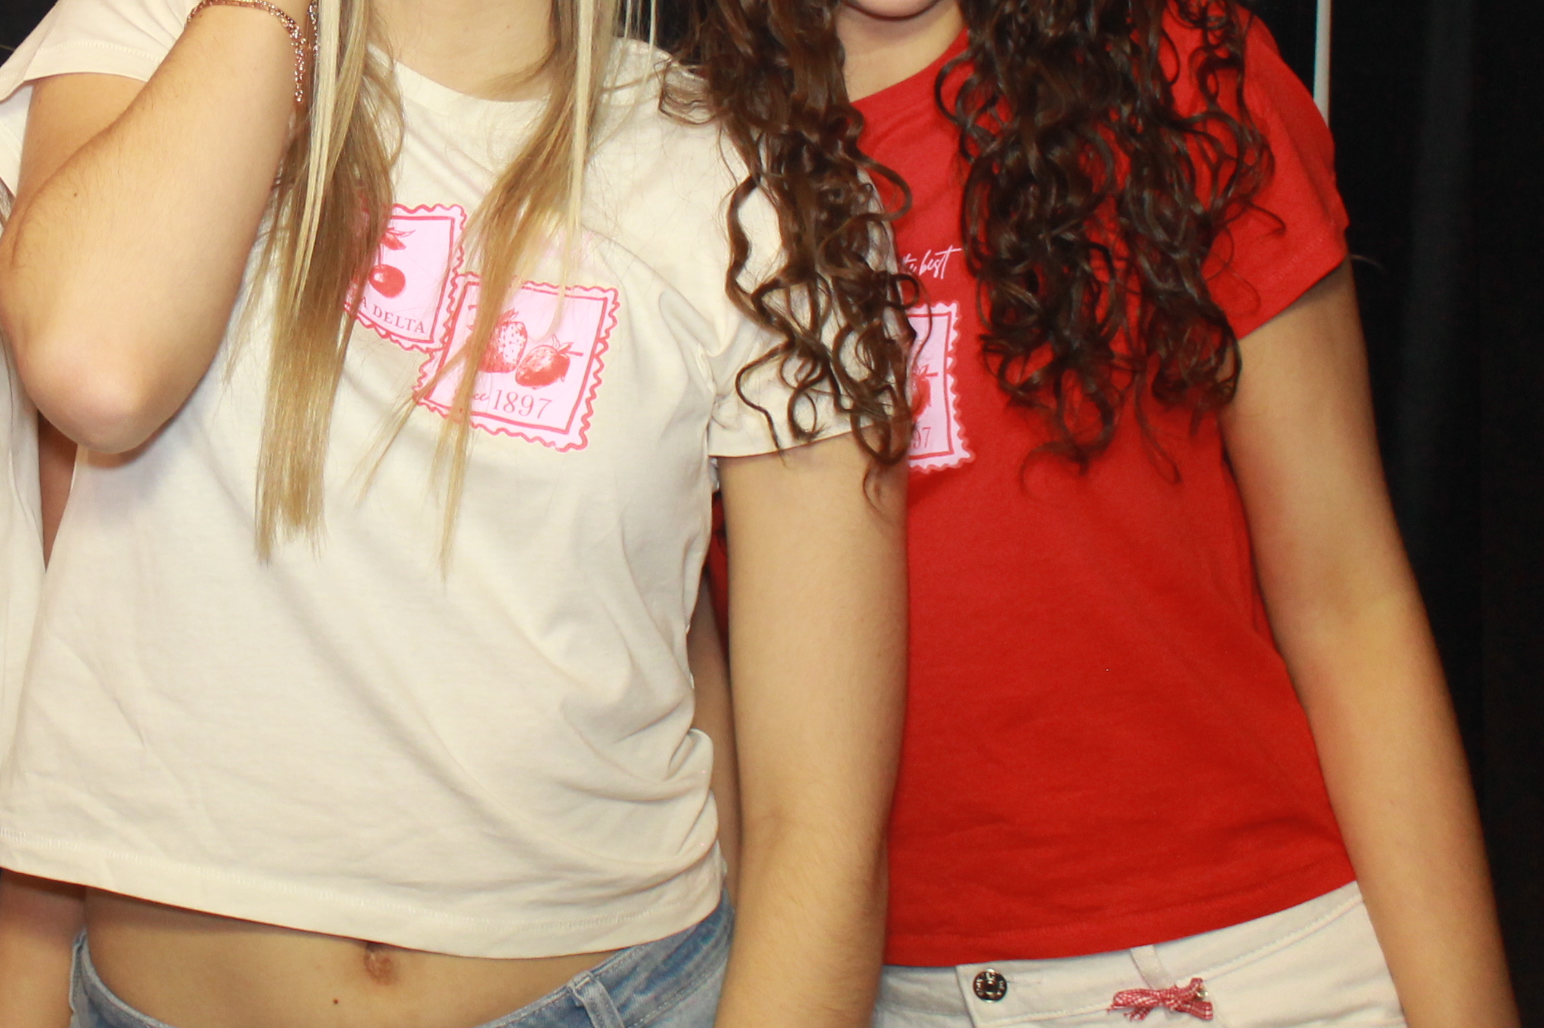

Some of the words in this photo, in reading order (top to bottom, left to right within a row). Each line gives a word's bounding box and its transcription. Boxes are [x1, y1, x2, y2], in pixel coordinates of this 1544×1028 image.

[372, 303, 426, 335] DELTA
[492, 389, 553, 420] 1897
[911, 426, 932, 450] 97
